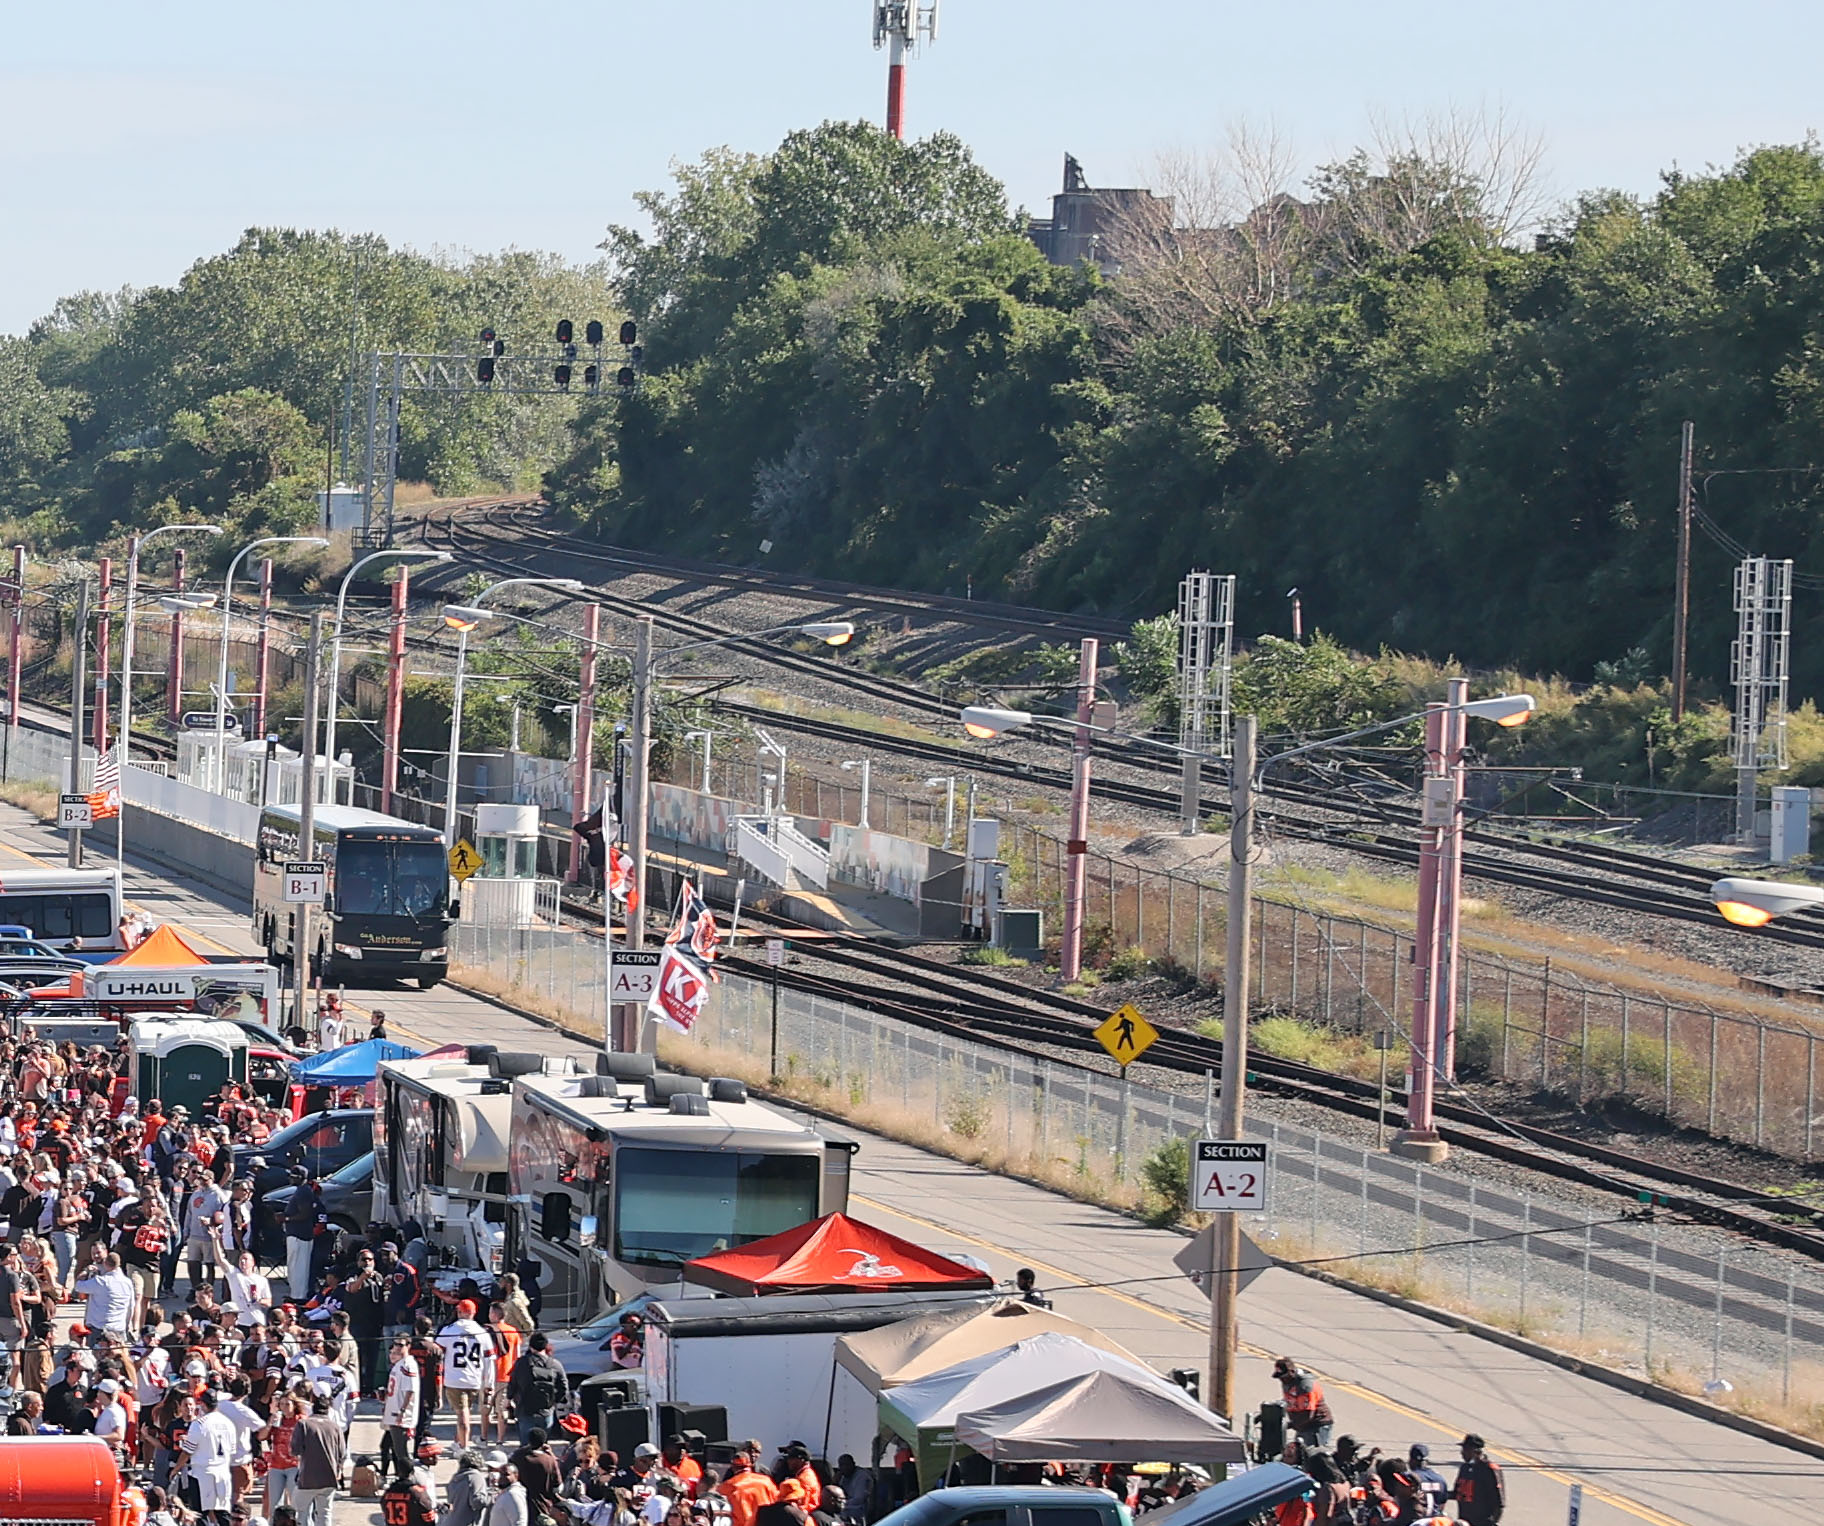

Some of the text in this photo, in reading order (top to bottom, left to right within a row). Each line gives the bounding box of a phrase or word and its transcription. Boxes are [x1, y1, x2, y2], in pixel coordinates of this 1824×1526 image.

[63, 809, 88, 821] B-2
[288, 865, 322, 873] SECTION
[290, 880, 318, 895] B-1
[615, 953, 658, 965] SECTION
[613, 973, 653, 992] A-3
[1204, 1146, 1262, 1158] SECTION
[1203, 1171, 1256, 1198] A-2
[453, 1342, 482, 1369] 24
[385, 1501, 409, 1526] 13
